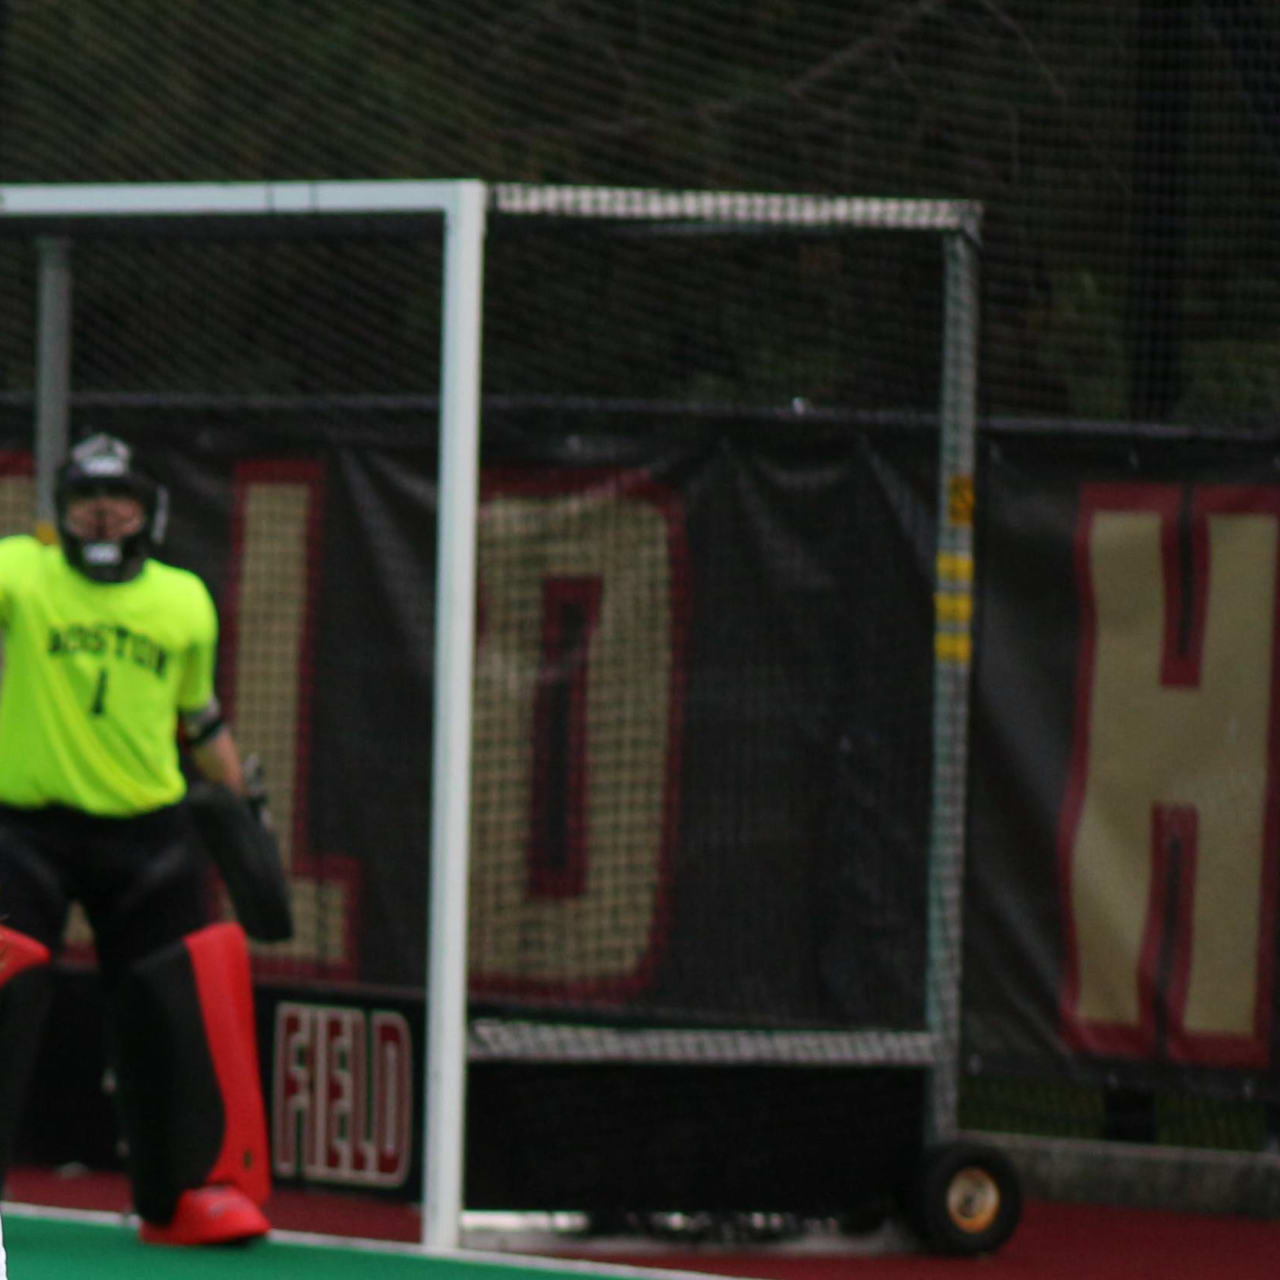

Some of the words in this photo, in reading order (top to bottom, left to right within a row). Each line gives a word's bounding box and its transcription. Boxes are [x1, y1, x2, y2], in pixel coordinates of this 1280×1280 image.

[46, 621, 169, 681] BOSTON
[91, 667, 111, 716] 1
[273, 1001, 413, 1189] FIELD
